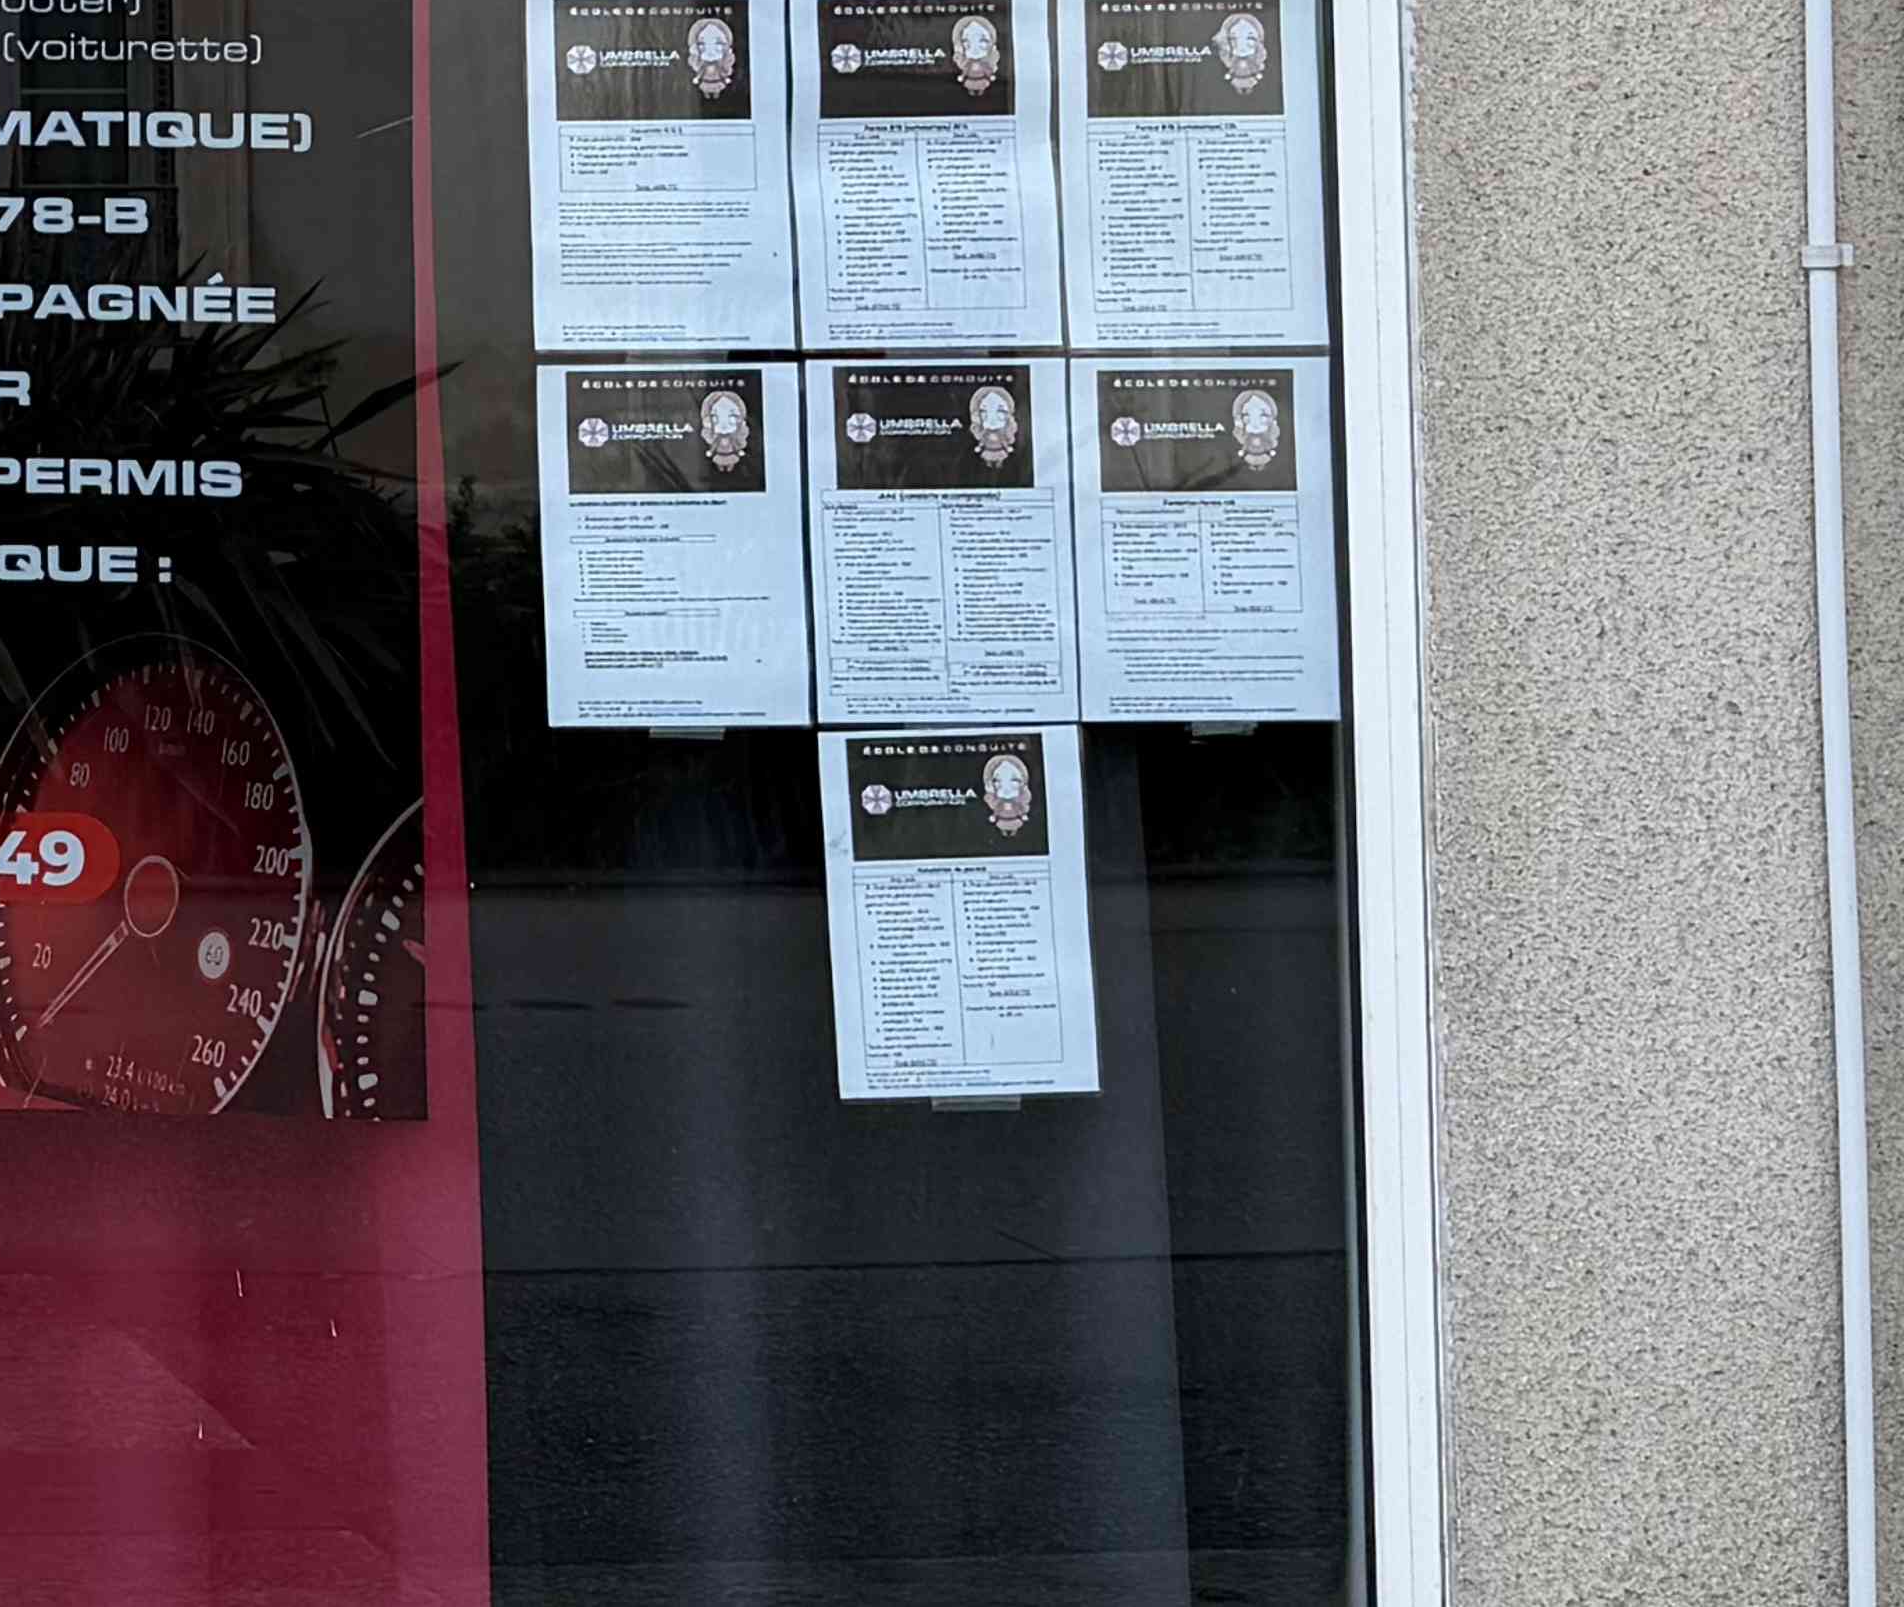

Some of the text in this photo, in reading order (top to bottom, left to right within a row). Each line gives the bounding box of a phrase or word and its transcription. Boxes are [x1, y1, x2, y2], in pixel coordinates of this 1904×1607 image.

[1, 32, 265, 66] (voiturette)
[145, 705, 172, 732] 120
[187, 708, 216, 736] 140
[103, 727, 130, 754] 100
[221, 738, 251, 767] 160
[70, 762, 91, 788] 80
[244, 782, 275, 812] 180
[253, 844, 289, 877] 200
[248, 917, 284, 952] 220
[32, 944, 52, 970] 20
[226, 983, 263, 1018] 240
[192, 1034, 226, 1070] 260
